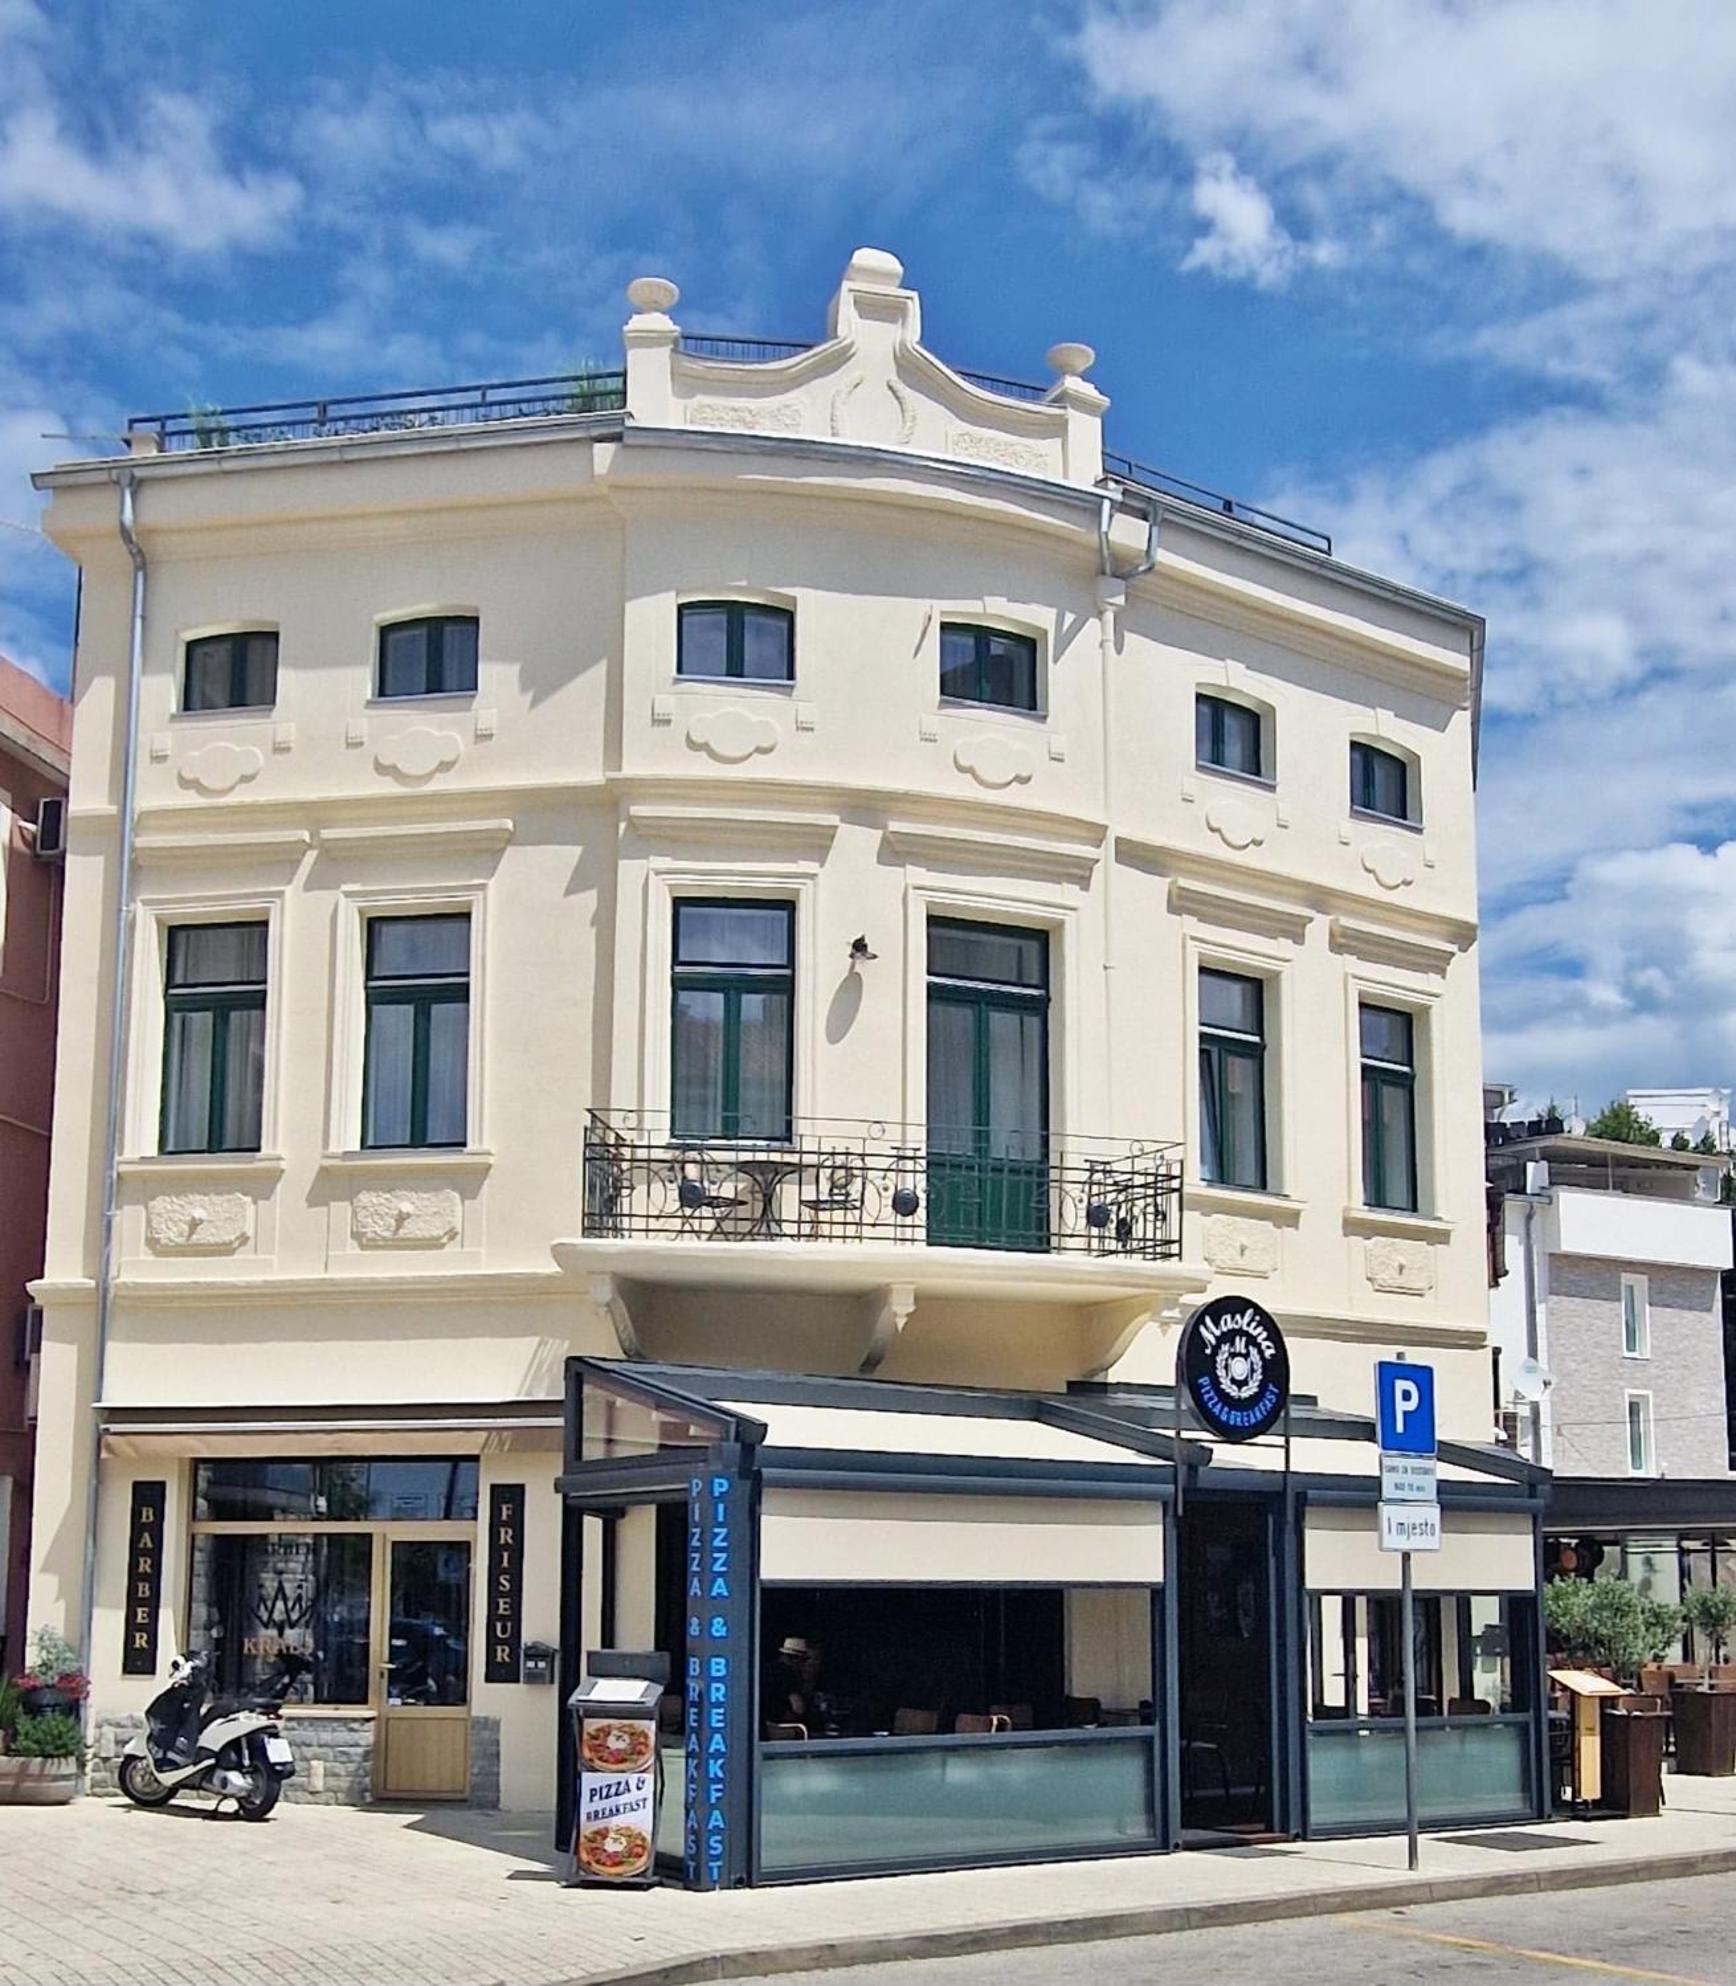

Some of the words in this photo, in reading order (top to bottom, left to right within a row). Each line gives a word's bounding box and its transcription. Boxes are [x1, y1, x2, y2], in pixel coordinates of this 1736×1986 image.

[1198, 1307, 1277, 1360] Maslina
[1394, 1378, 1419, 1434] P
[689, 1478, 702, 1596] PIZZA
[710, 1477, 730, 1597] PIZZA
[1396, 1517, 1436, 1540] mjesto
[133, 1506, 155, 1649] BARBER
[495, 1503, 514, 1663] FRISEUR
[689, 1616, 701, 1636] &
[711, 1616, 728, 1637] &
[589, 1779, 631, 1803] PIZZA
[636, 1776, 646, 1791] &
[686, 1657, 701, 1880] BREAKFAST
[708, 1657, 728, 1881] BREAKFAST
[586, 1797, 648, 1823] BREAKFAST
